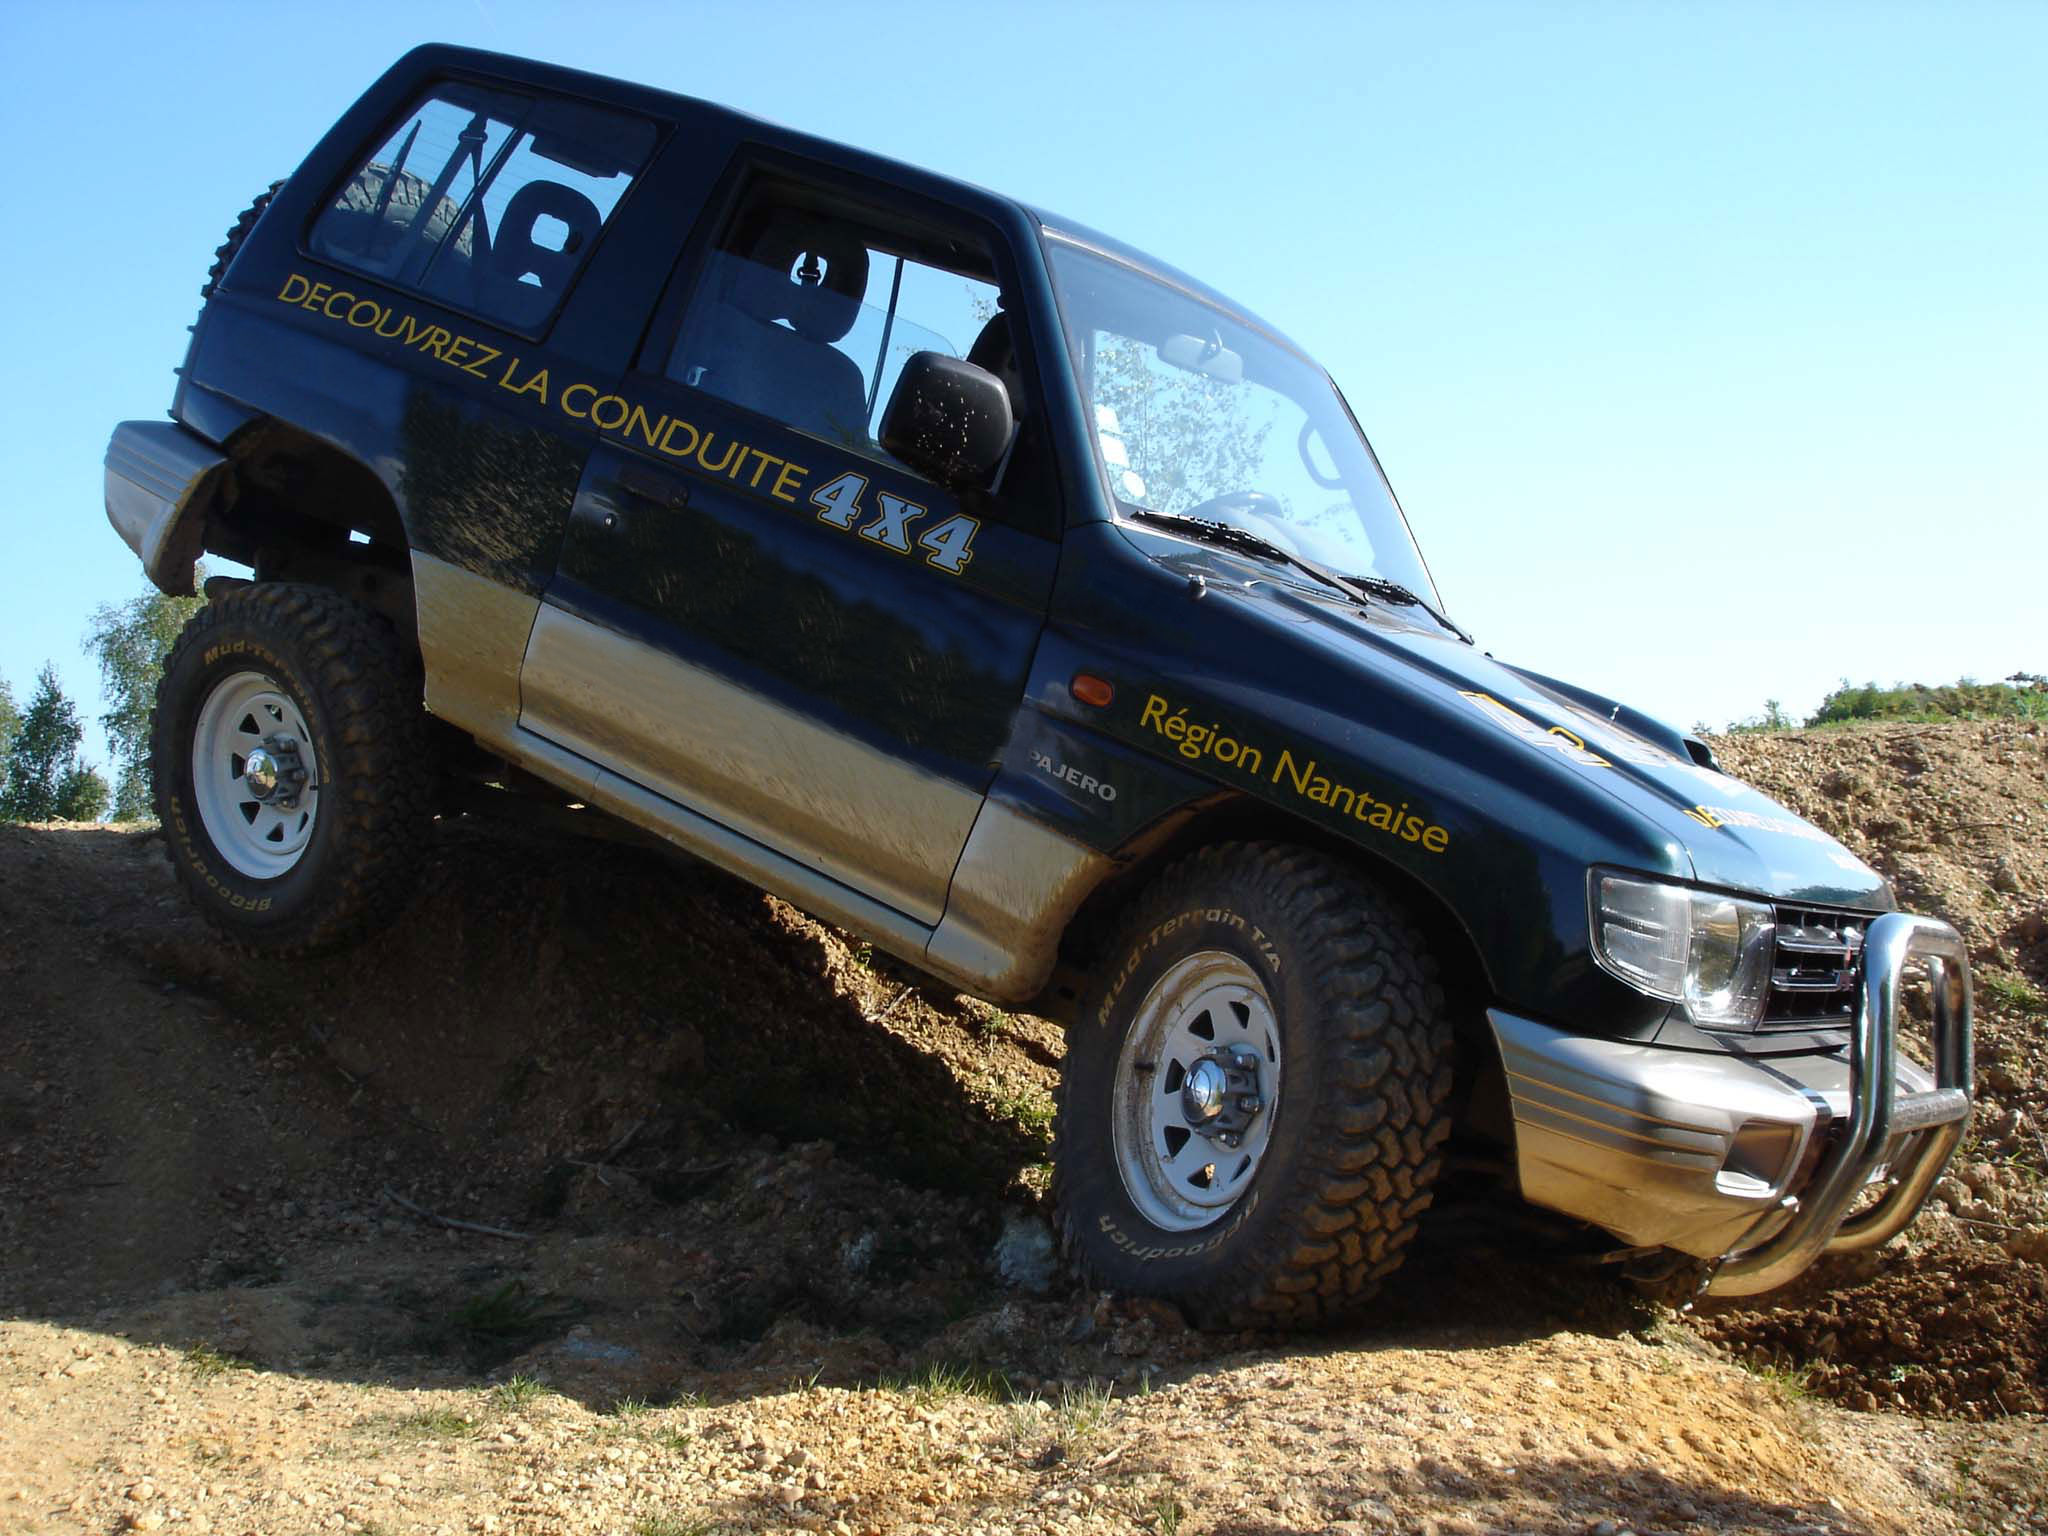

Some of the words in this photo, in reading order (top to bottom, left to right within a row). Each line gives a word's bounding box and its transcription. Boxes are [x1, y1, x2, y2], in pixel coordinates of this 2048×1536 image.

[277, 273, 502, 379] DECOUVREZ
[498, 357, 549, 405] LA
[561, 383, 810, 502] CONDUITE
[1140, 694, 1262, 774] Région
[1272, 749, 1450, 854] Nantaise
